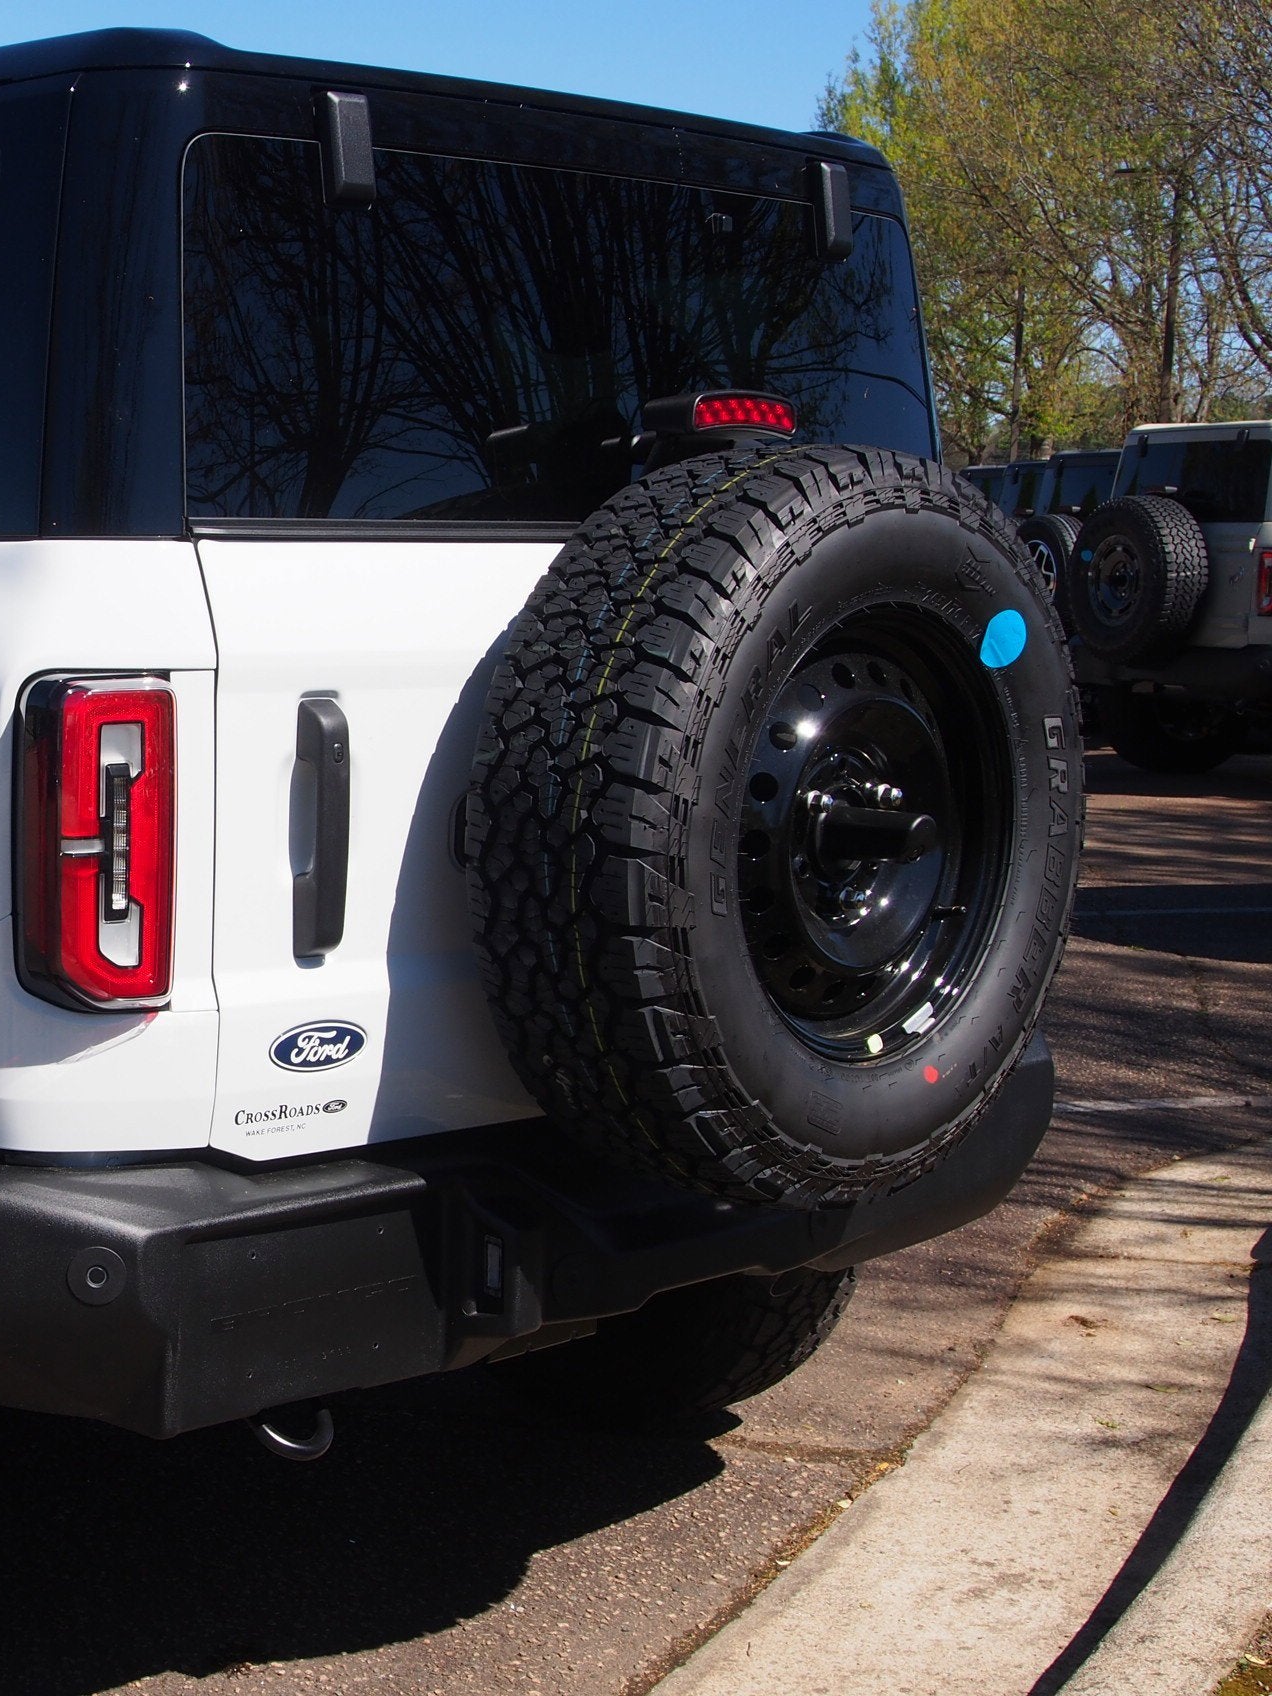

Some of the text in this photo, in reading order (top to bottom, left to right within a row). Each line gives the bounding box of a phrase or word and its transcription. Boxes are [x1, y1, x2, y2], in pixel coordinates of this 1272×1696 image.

[710, 599, 813, 917] GENERAL
[1008, 714, 1070, 1014] GRABBER
[245, 1129, 266, 1137] WAKE
[296, 1122, 307, 1130] NC
[291, 1031, 351, 1063] Ford
